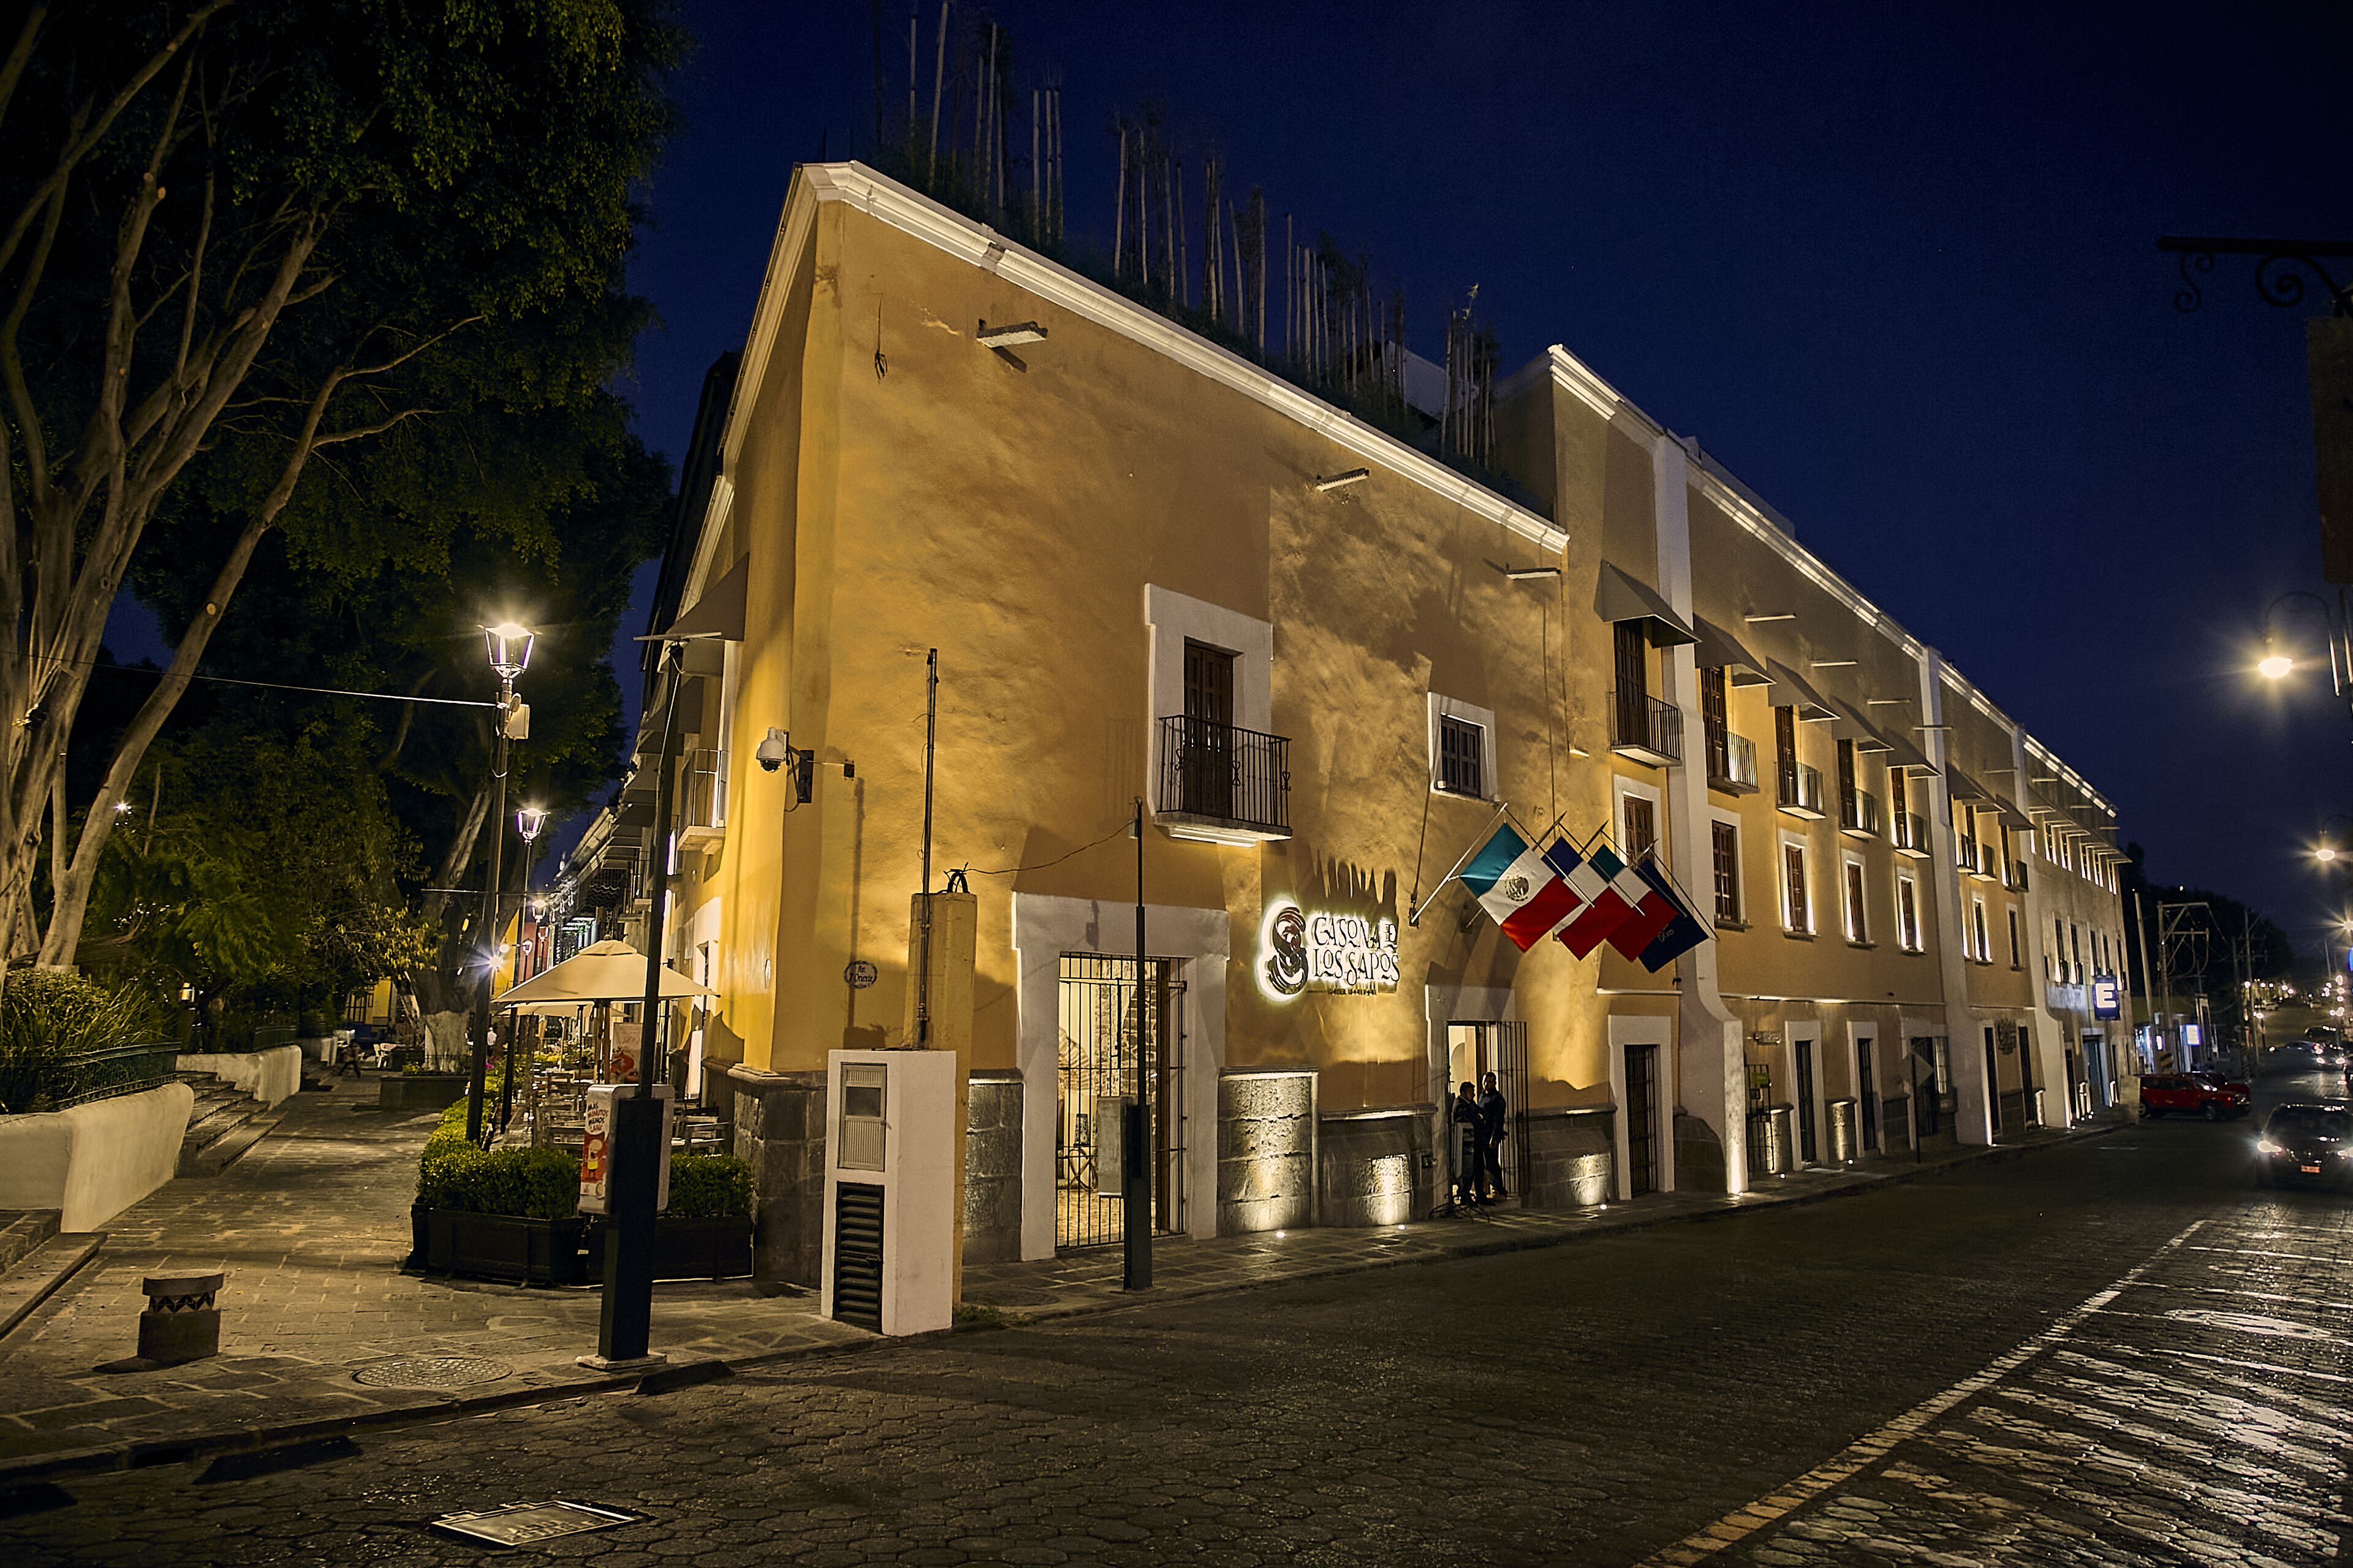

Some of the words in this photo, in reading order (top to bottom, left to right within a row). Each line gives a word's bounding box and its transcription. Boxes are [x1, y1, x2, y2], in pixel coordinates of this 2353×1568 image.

[1313, 917, 1381, 950] CASONA
[849, 972, 854, 982] 7
[1314, 949, 1343, 979] LOS
[1347, 951, 1400, 986] SAPOS
[2095, 983, 2116, 1009] E
[588, 1116, 605, 1126] MENOS
